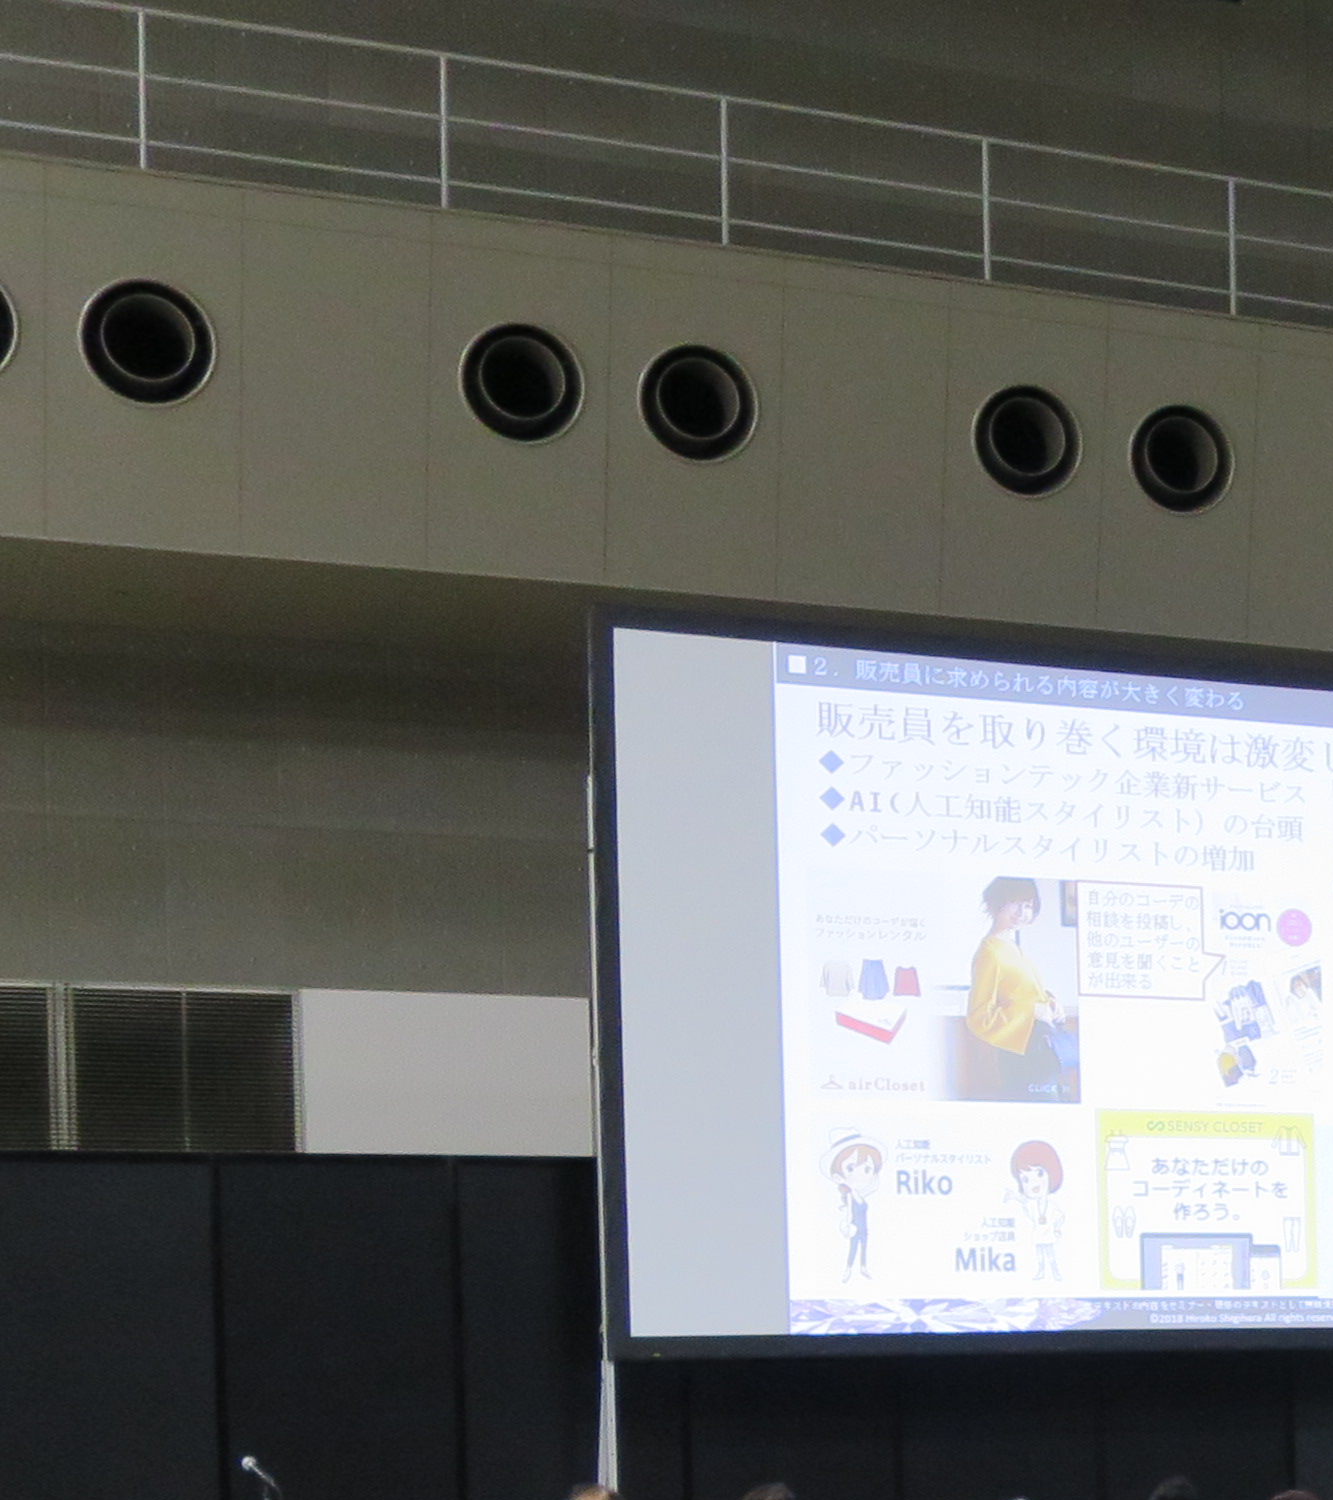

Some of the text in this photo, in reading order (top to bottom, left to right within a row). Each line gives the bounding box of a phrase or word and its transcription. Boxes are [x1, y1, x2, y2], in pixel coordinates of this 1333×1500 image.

[856, 659, 1244, 711] 販売員に求められる内容が大きく変わる
[850, 752, 1306, 804] ファッションテック企業新サービス
[849, 826, 1255, 871] パーソナルスタイリストの増加
[1088, 888, 1200, 911] 自分のコーデの
[1086, 911, 1191, 932] 相談を投稿し、
[815, 927, 926, 941] ファッションレンタル
[1086, 931, 1200, 951] 他のユーザーの
[1087, 950, 1200, 973] 意見を聞くこと
[1088, 972, 1153, 990] が出来る
[848, 1076, 926, 1092] airCloset
[1167, 1120, 1264, 1134] SENSY CLOSET
[895, 1153, 992, 1165] パーソナルスタイリスト
[1151, 1156, 1269, 1176] あなただけの
[896, 1169, 954, 1195] Riko
[1132, 1178, 1288, 1199] コーディネートを
[1173, 1201, 1241, 1221] 作ろう。
[954, 1246, 1017, 1272] Mika
